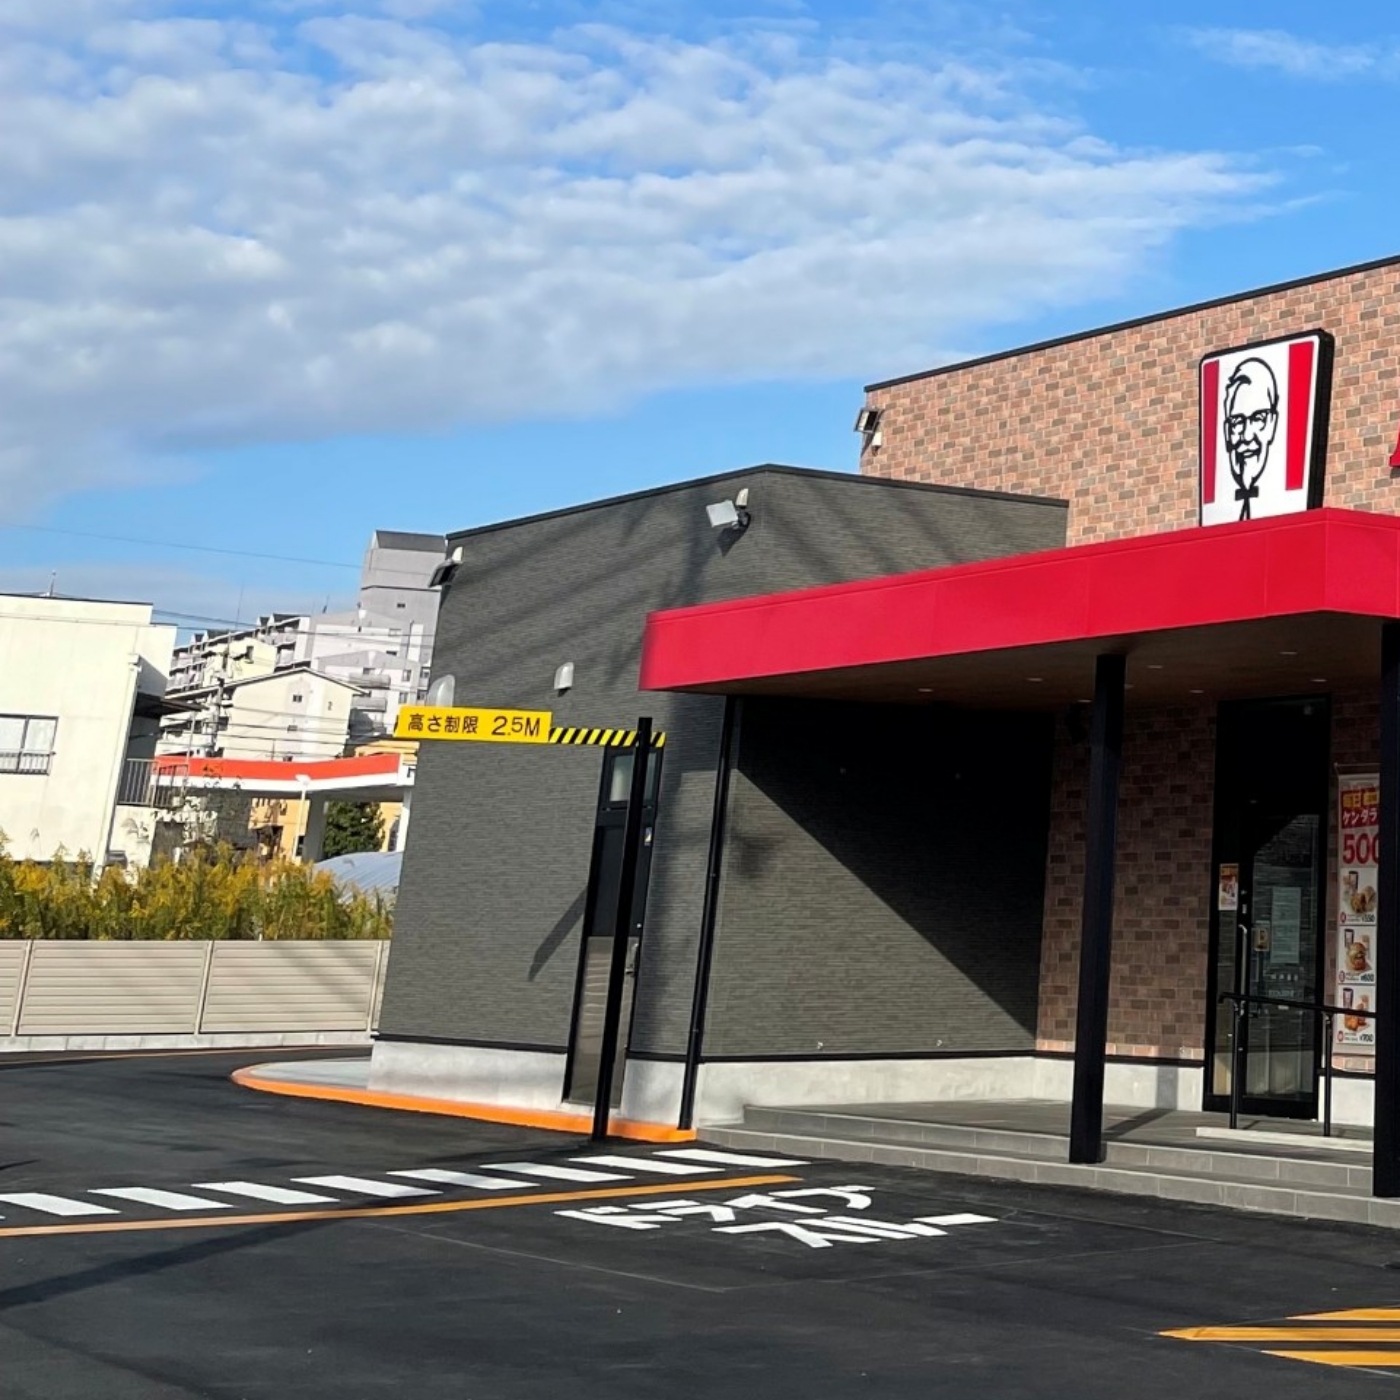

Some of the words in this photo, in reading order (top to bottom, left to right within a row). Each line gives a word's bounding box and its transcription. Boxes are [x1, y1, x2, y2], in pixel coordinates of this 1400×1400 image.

[408, 713, 479, 734] 高さ制限
[491, 716, 541, 737] 2.5M
[554, 1186, 874, 1229] ドライブ
[711, 1213, 998, 1248] スルー
